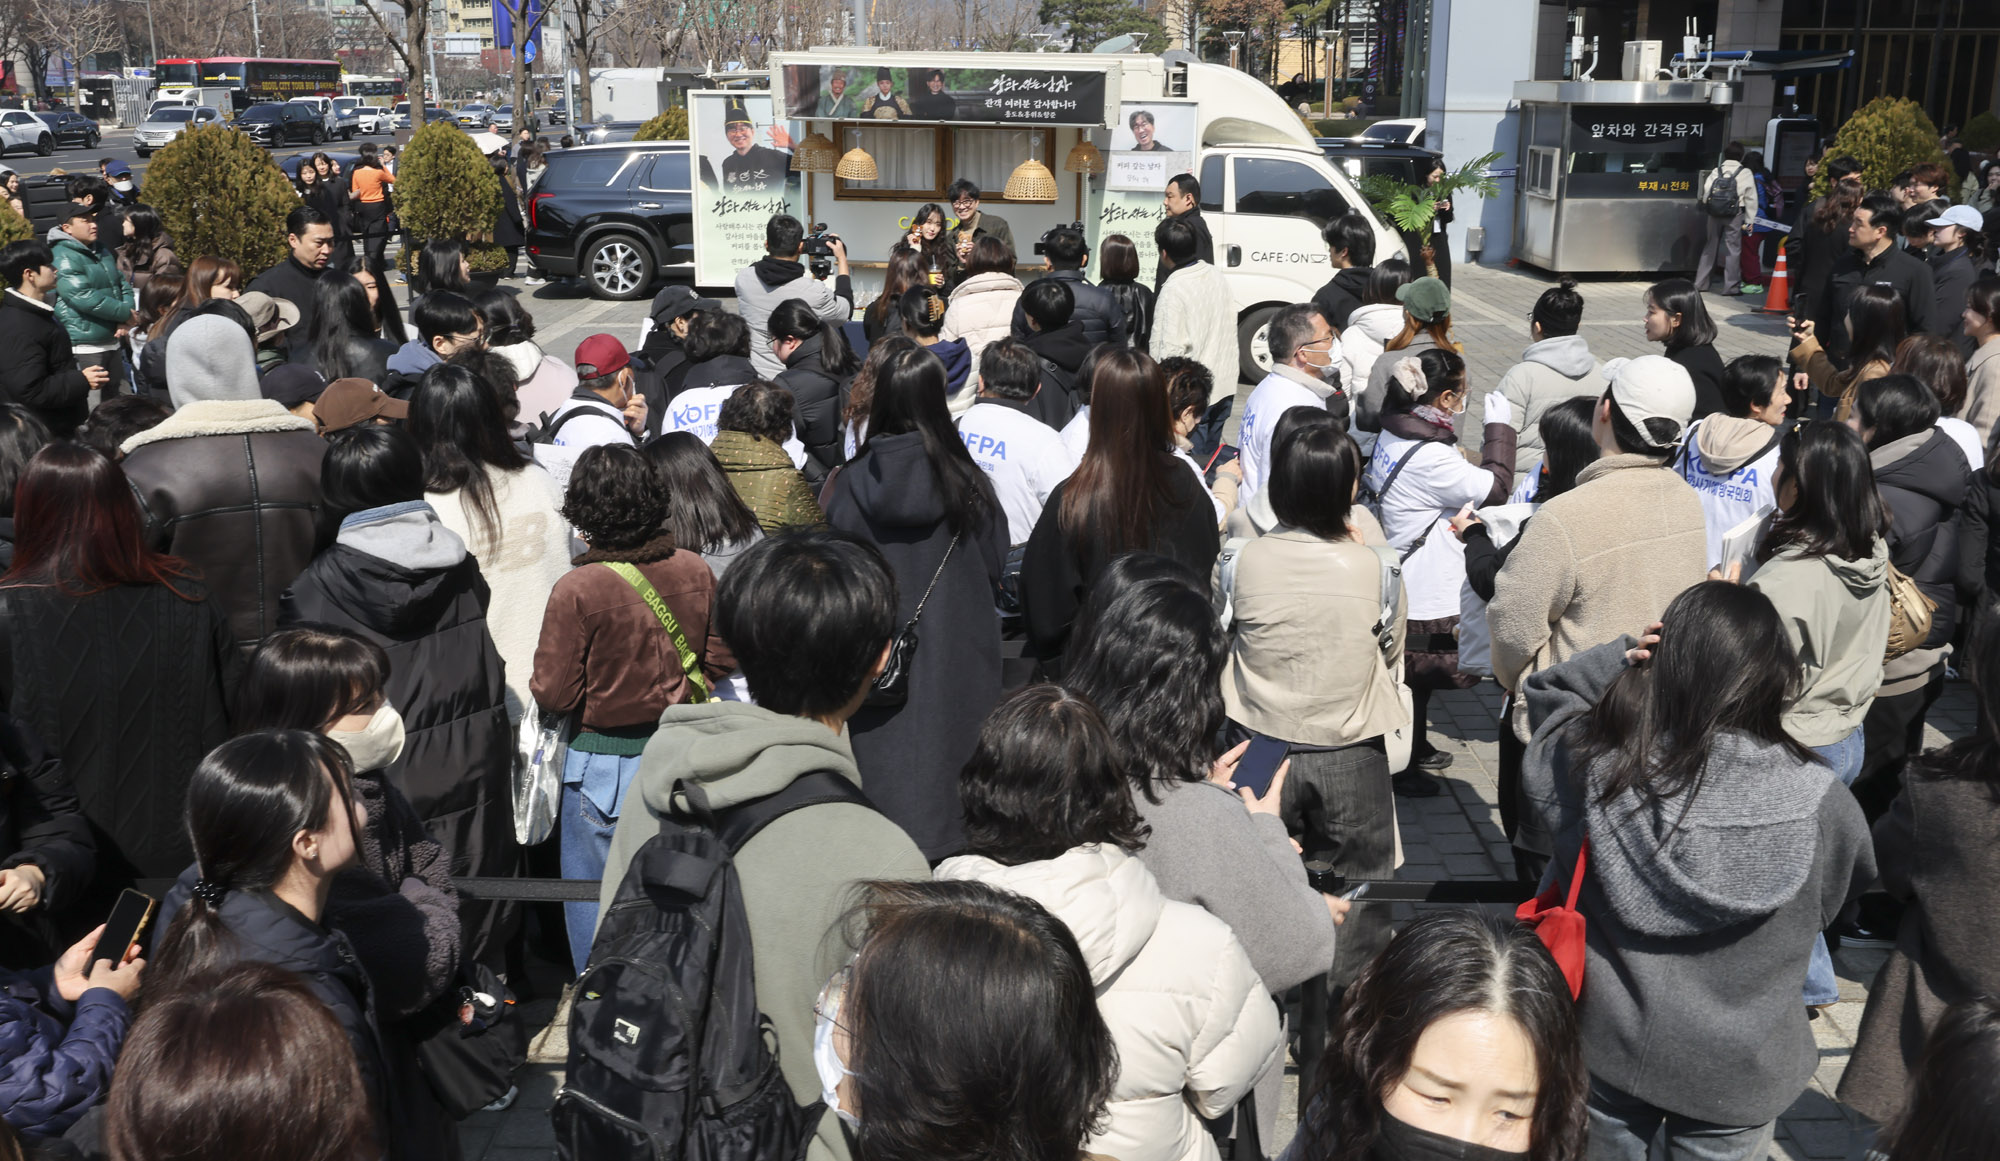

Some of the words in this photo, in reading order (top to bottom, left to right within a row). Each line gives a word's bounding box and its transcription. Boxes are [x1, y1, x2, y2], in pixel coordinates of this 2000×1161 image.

[279, 81, 290, 90] CITY
[292, 81, 305, 90] TOUR
[305, 81, 315, 90] BUS
[985, 98, 1002, 108] 관객
[1005, 98, 1031, 108] 여러분
[1034, 99, 1077, 110] 감사합니다
[1591, 123, 1636, 138] 앞차와
[1643, 122, 1704, 138] 간격유지
[1637, 180, 1659, 191] 부재
[1660, 183, 1668, 191] 시
[1670, 180, 1690, 191] 전화
[1250, 251, 1309, 263] CAFE:ON
[673, 404, 723, 429] KOF
[1687, 451, 1758, 487] KOPA
[642, 588, 679, 634] BAGGU
